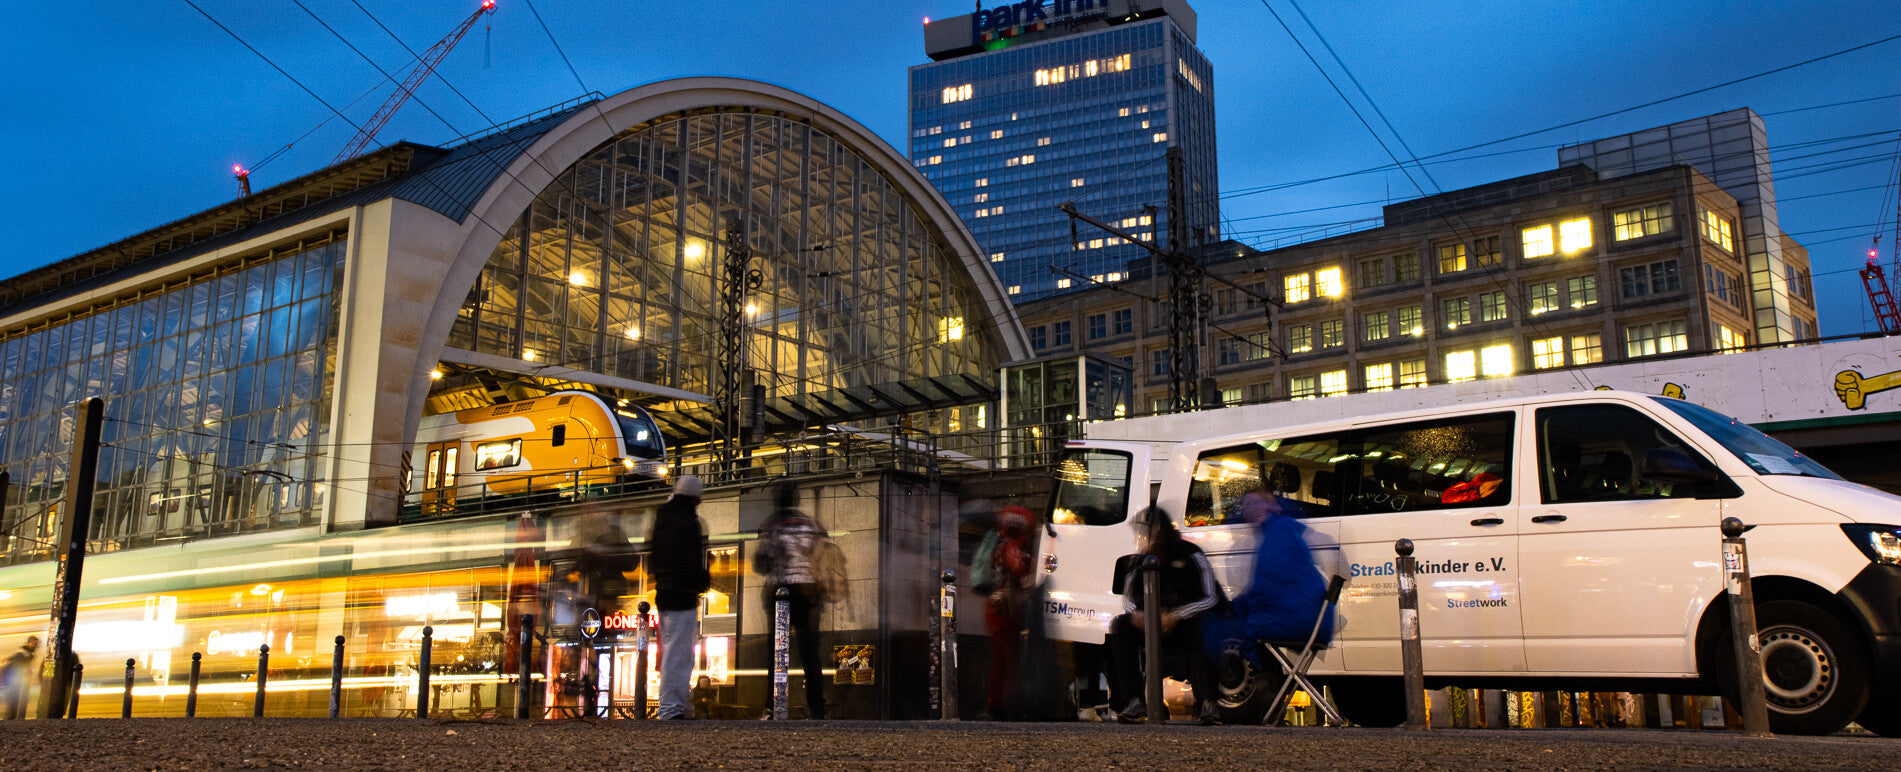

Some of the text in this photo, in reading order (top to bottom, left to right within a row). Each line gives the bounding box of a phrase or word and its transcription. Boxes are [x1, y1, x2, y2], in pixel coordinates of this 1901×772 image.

[973, 0, 1048, 47] park
[1351, 557, 1506, 577] Straßkinder e.V.
[1447, 597, 1507, 608] Streetwork
[604, 611, 646, 629] DÖNE
